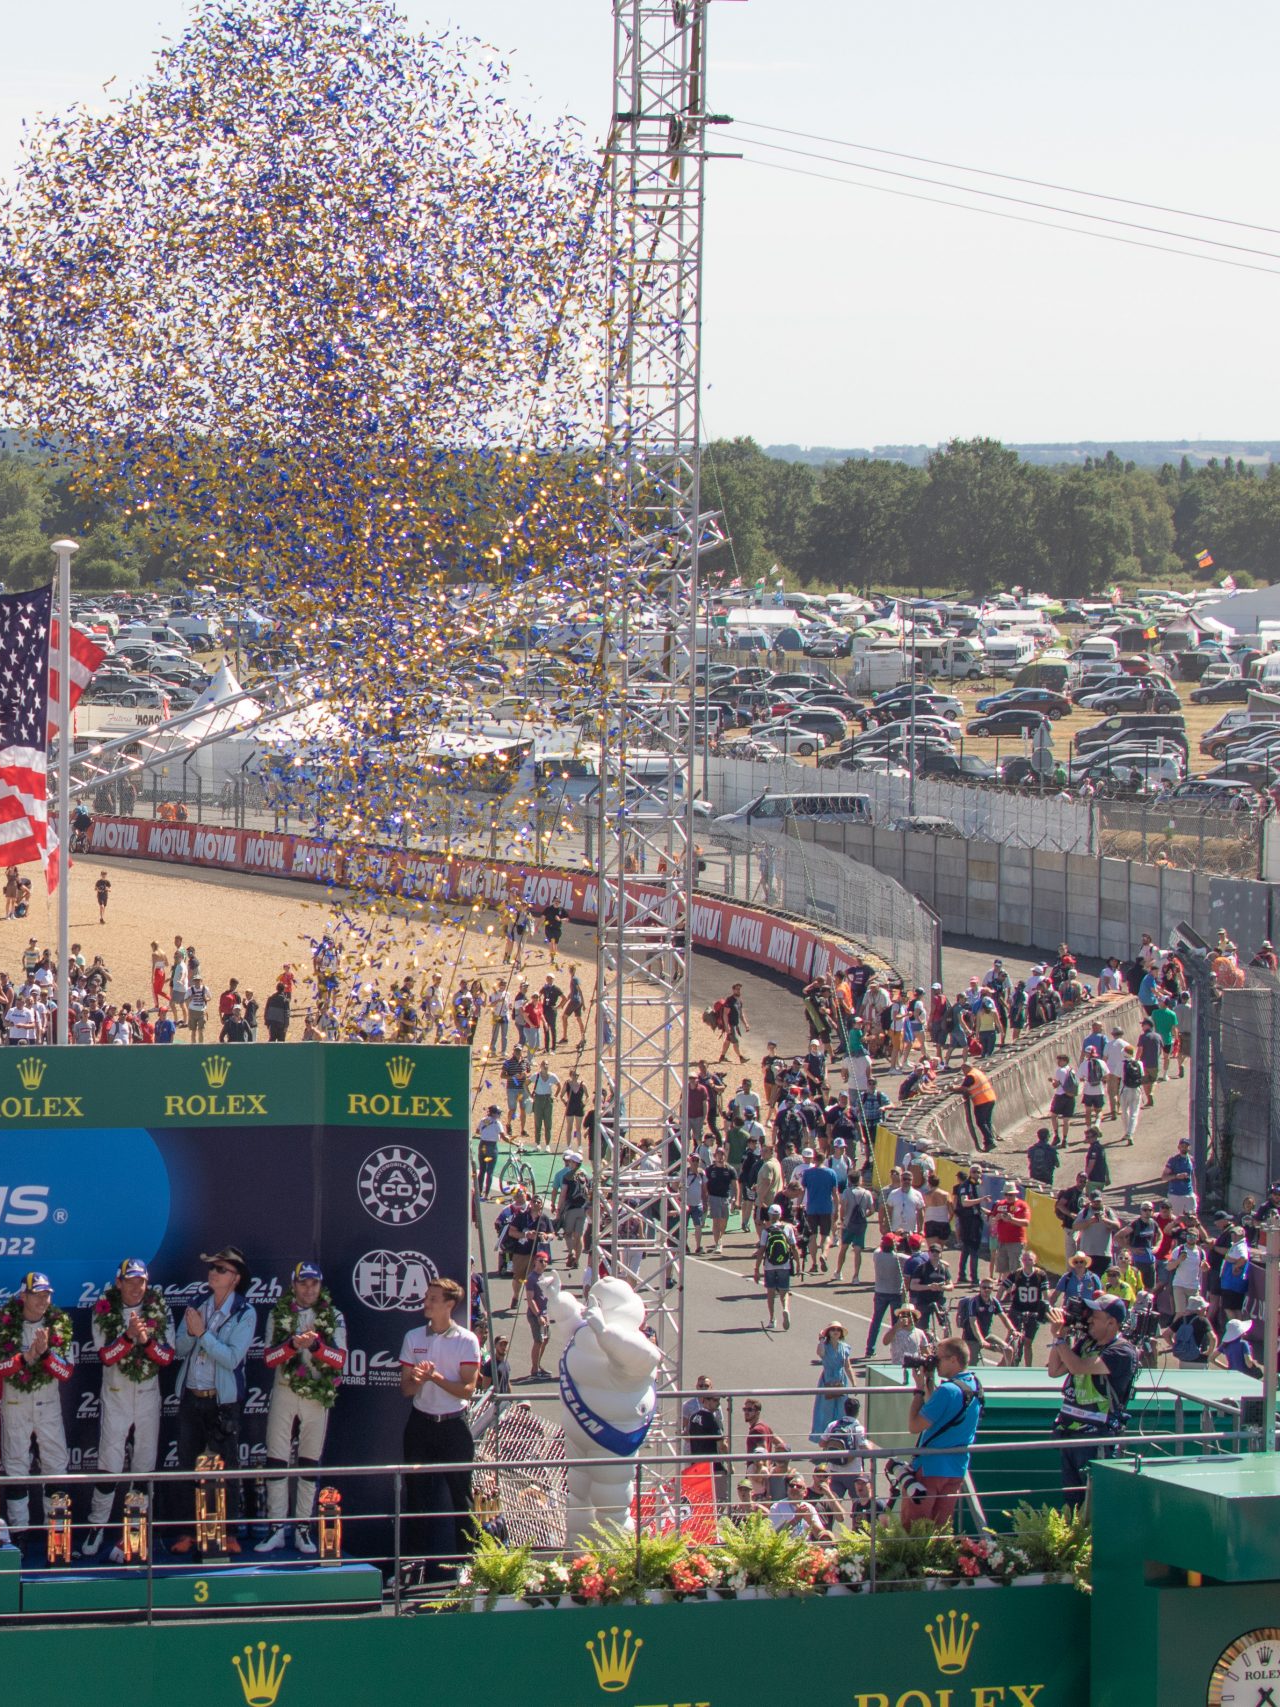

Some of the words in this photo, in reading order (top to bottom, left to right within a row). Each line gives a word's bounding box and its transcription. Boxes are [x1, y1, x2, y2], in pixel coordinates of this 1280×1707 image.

[92, 822, 139, 850] MOTUL
[148, 827, 190, 856] MOTUL
[193, 831, 237, 862] MOTUL
[244, 838, 284, 868] MOTUL
[524, 875, 573, 910] MOTUL
[728, 914, 763, 953] MOTUL
[767, 926, 799, 968] MOTUL
[165, 1094, 267, 1116] ROLEX
[348, 1093, 452, 1117] ROLEX
[375, 1162, 407, 1180] AUTOMOBILE
[381, 1184, 412, 1196] CO
[245, 1277, 282, 1297] 24h
[324, 1349, 343, 1362] MOTUL
[78, 1392, 100, 1412] 24
[245, 1388, 270, 1407] 24
[194, 1581, 209, 1603] 3
